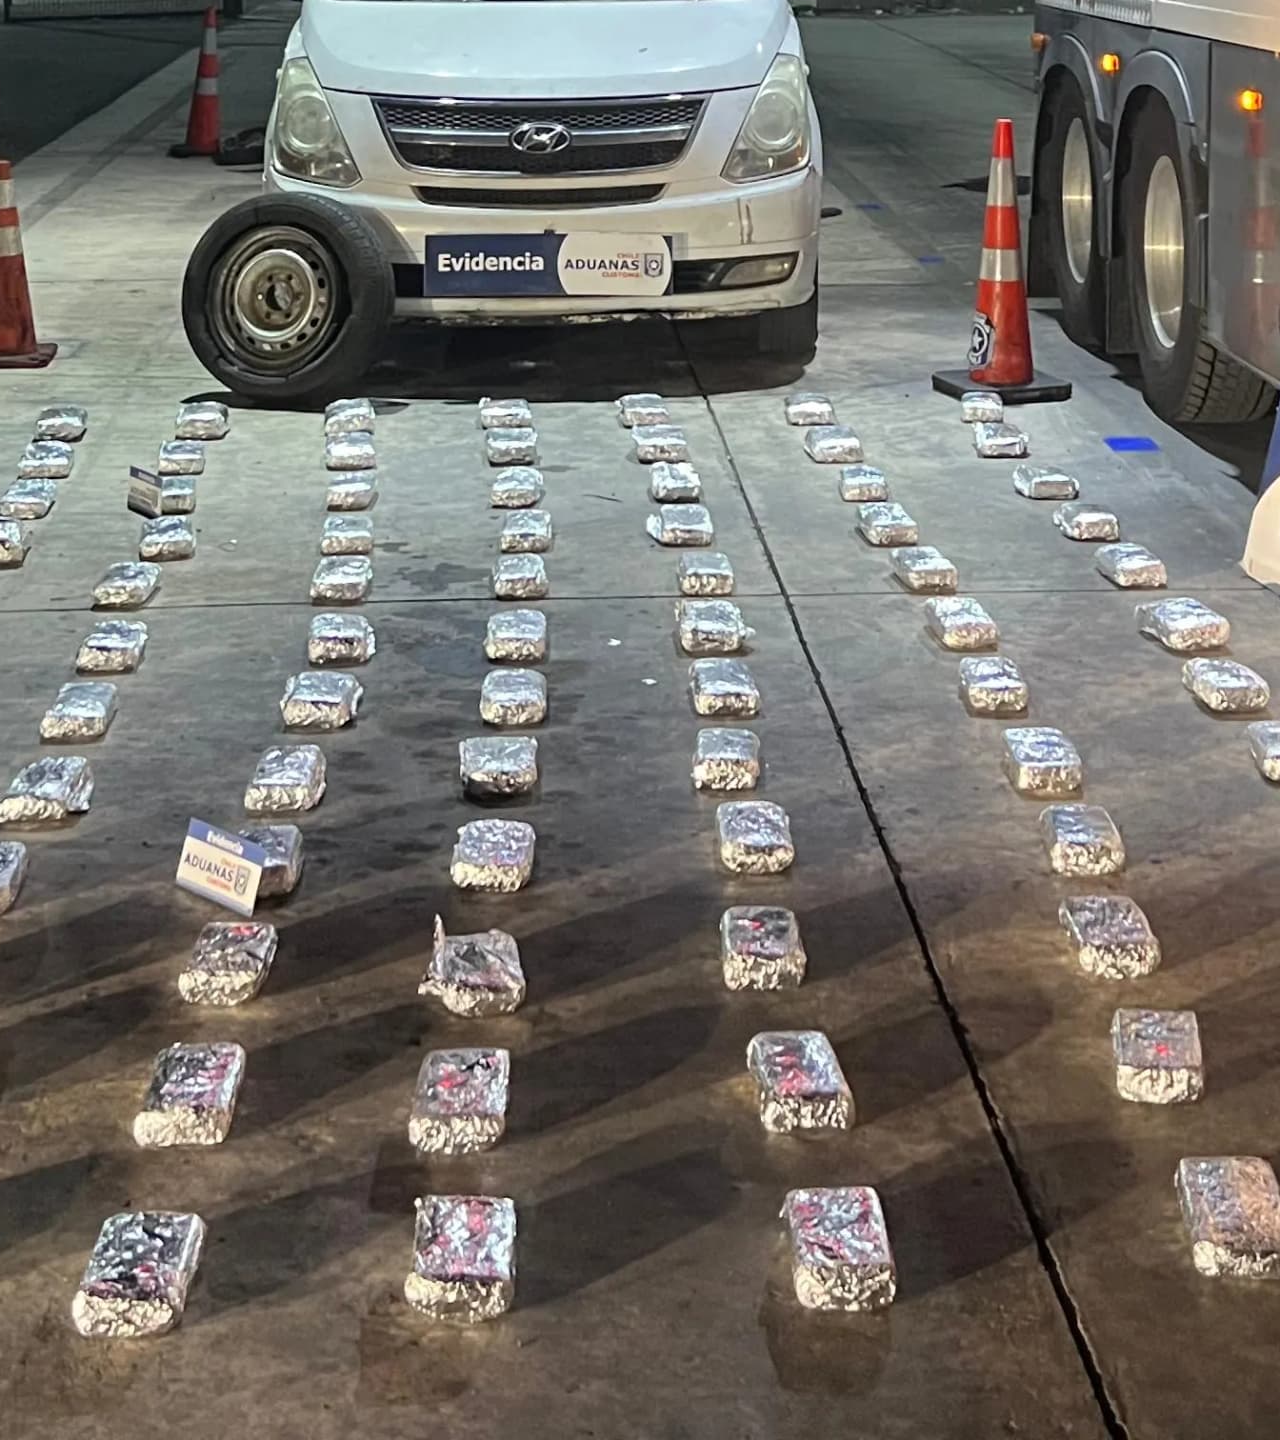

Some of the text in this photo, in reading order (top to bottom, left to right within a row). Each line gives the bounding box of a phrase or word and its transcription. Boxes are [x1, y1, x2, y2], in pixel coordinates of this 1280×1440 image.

[437, 252, 544, 272] Evidencia
[564, 258, 640, 271] ADUANAS
[184, 852, 235, 882] ADUANAS
